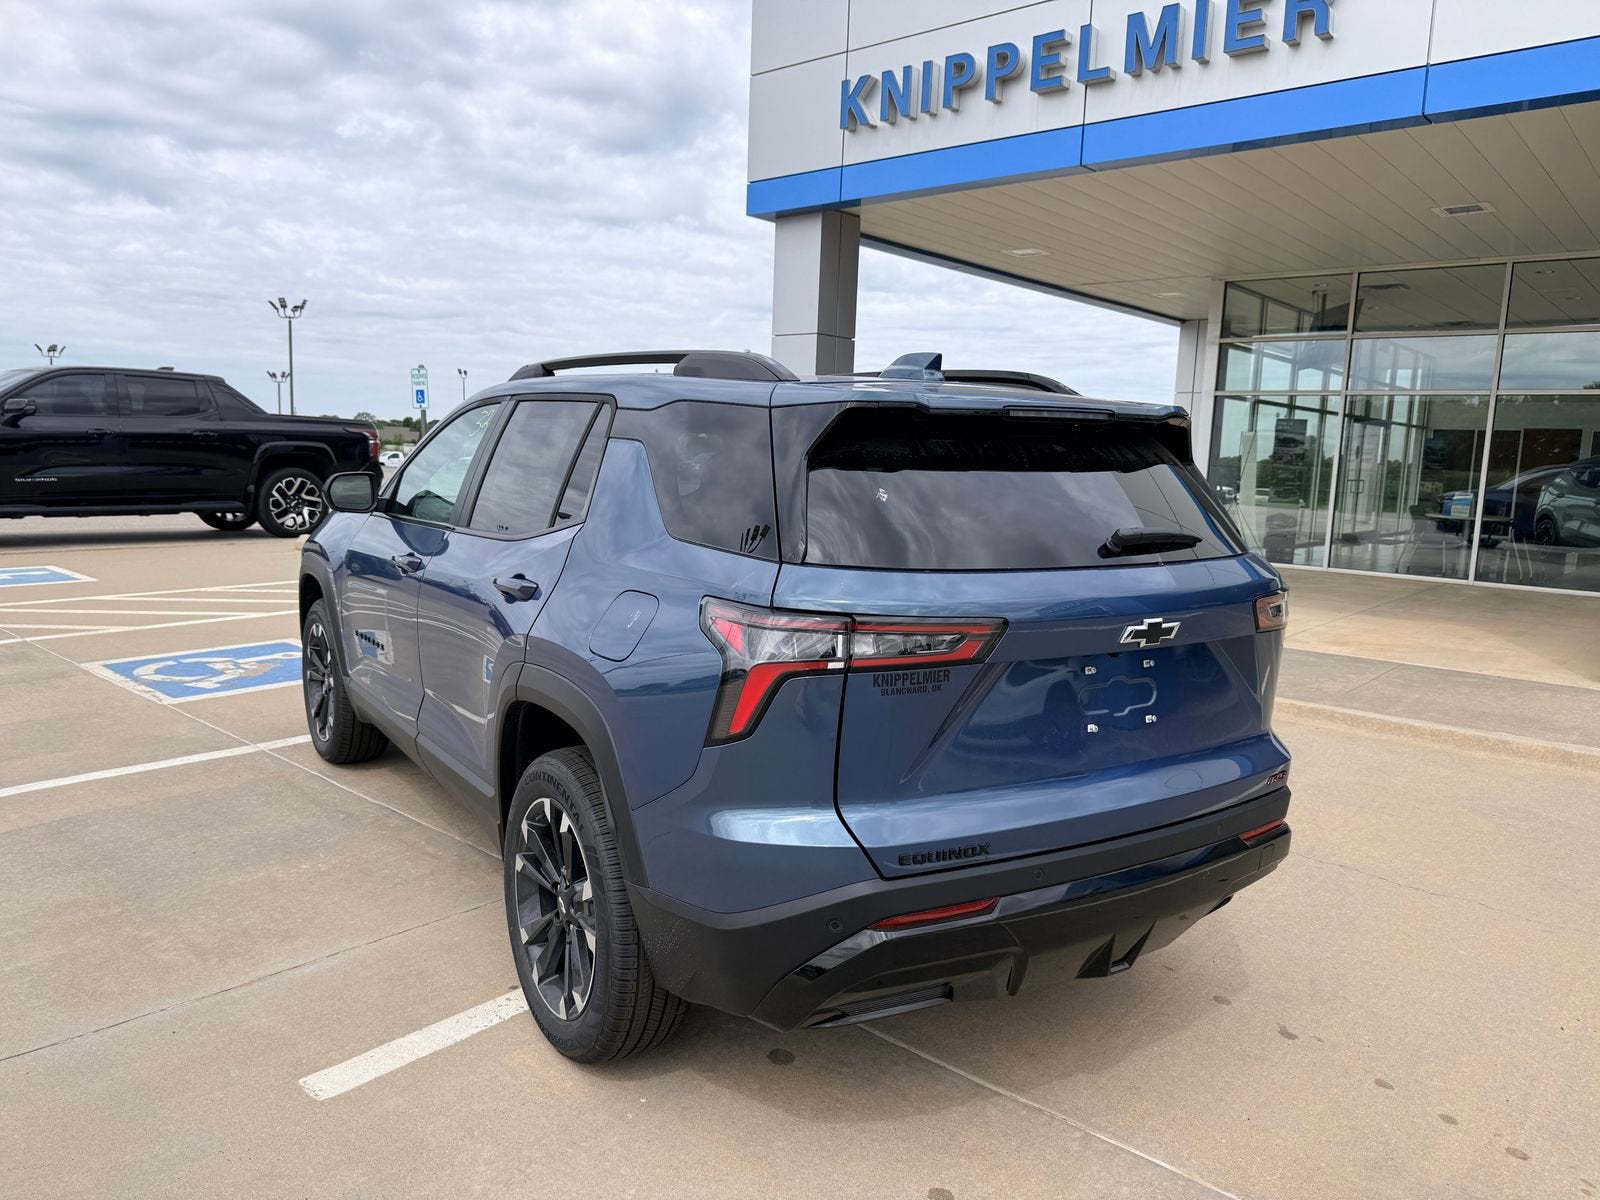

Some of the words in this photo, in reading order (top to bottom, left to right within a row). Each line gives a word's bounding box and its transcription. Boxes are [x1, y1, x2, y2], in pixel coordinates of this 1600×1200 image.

[840, 0, 1334, 132] KNIPPELMIER
[872, 669, 951, 688] KNIPPELMIER
[881, 685, 930, 697] BLANCHARD,
[898, 842, 991, 866] EQUINOX
